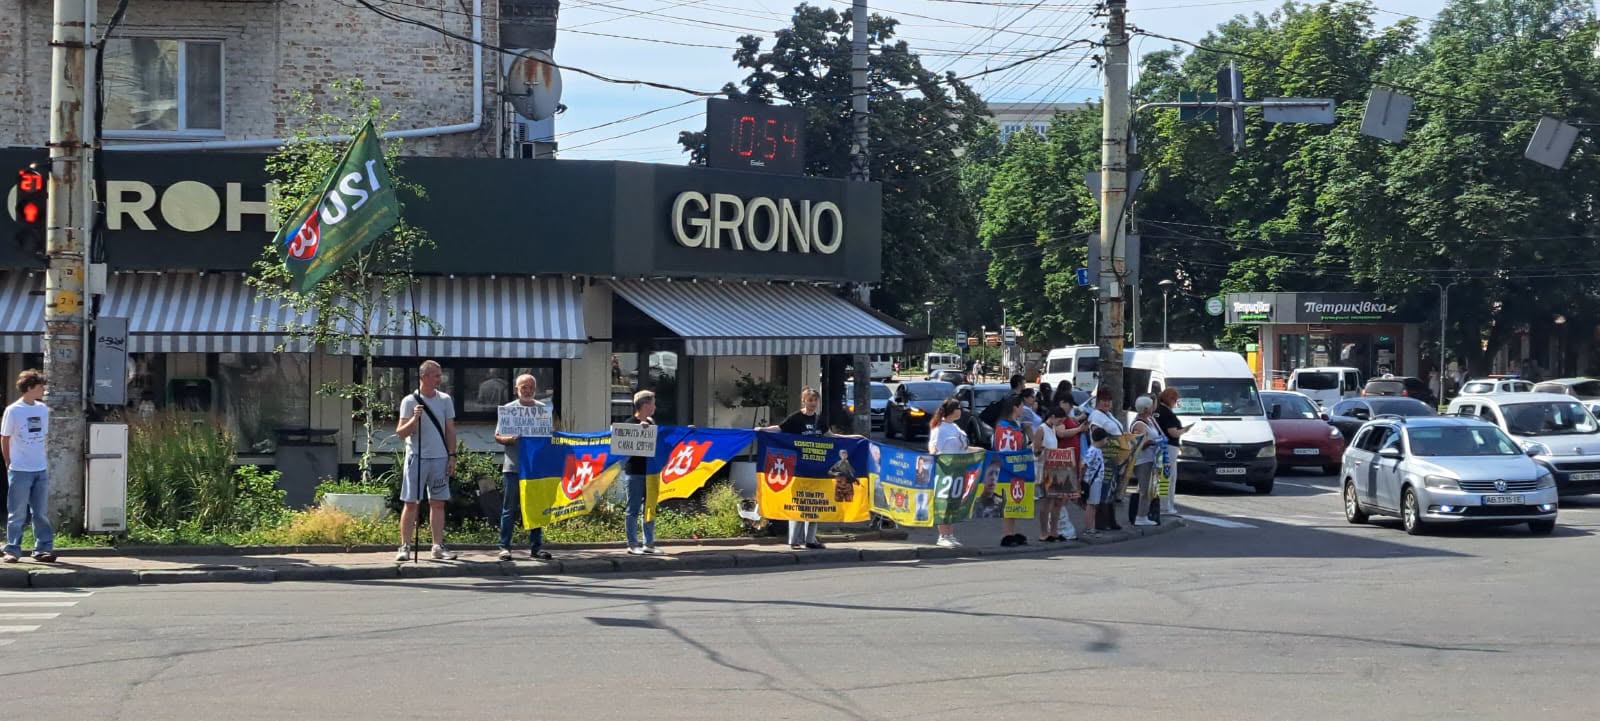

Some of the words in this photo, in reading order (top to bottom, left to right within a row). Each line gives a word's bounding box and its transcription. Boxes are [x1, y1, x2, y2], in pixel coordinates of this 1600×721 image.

[20, 174, 43, 191] 27
[671, 190, 843, 255] GRONO
[1304, 301, 1387, 314] Петриківка
